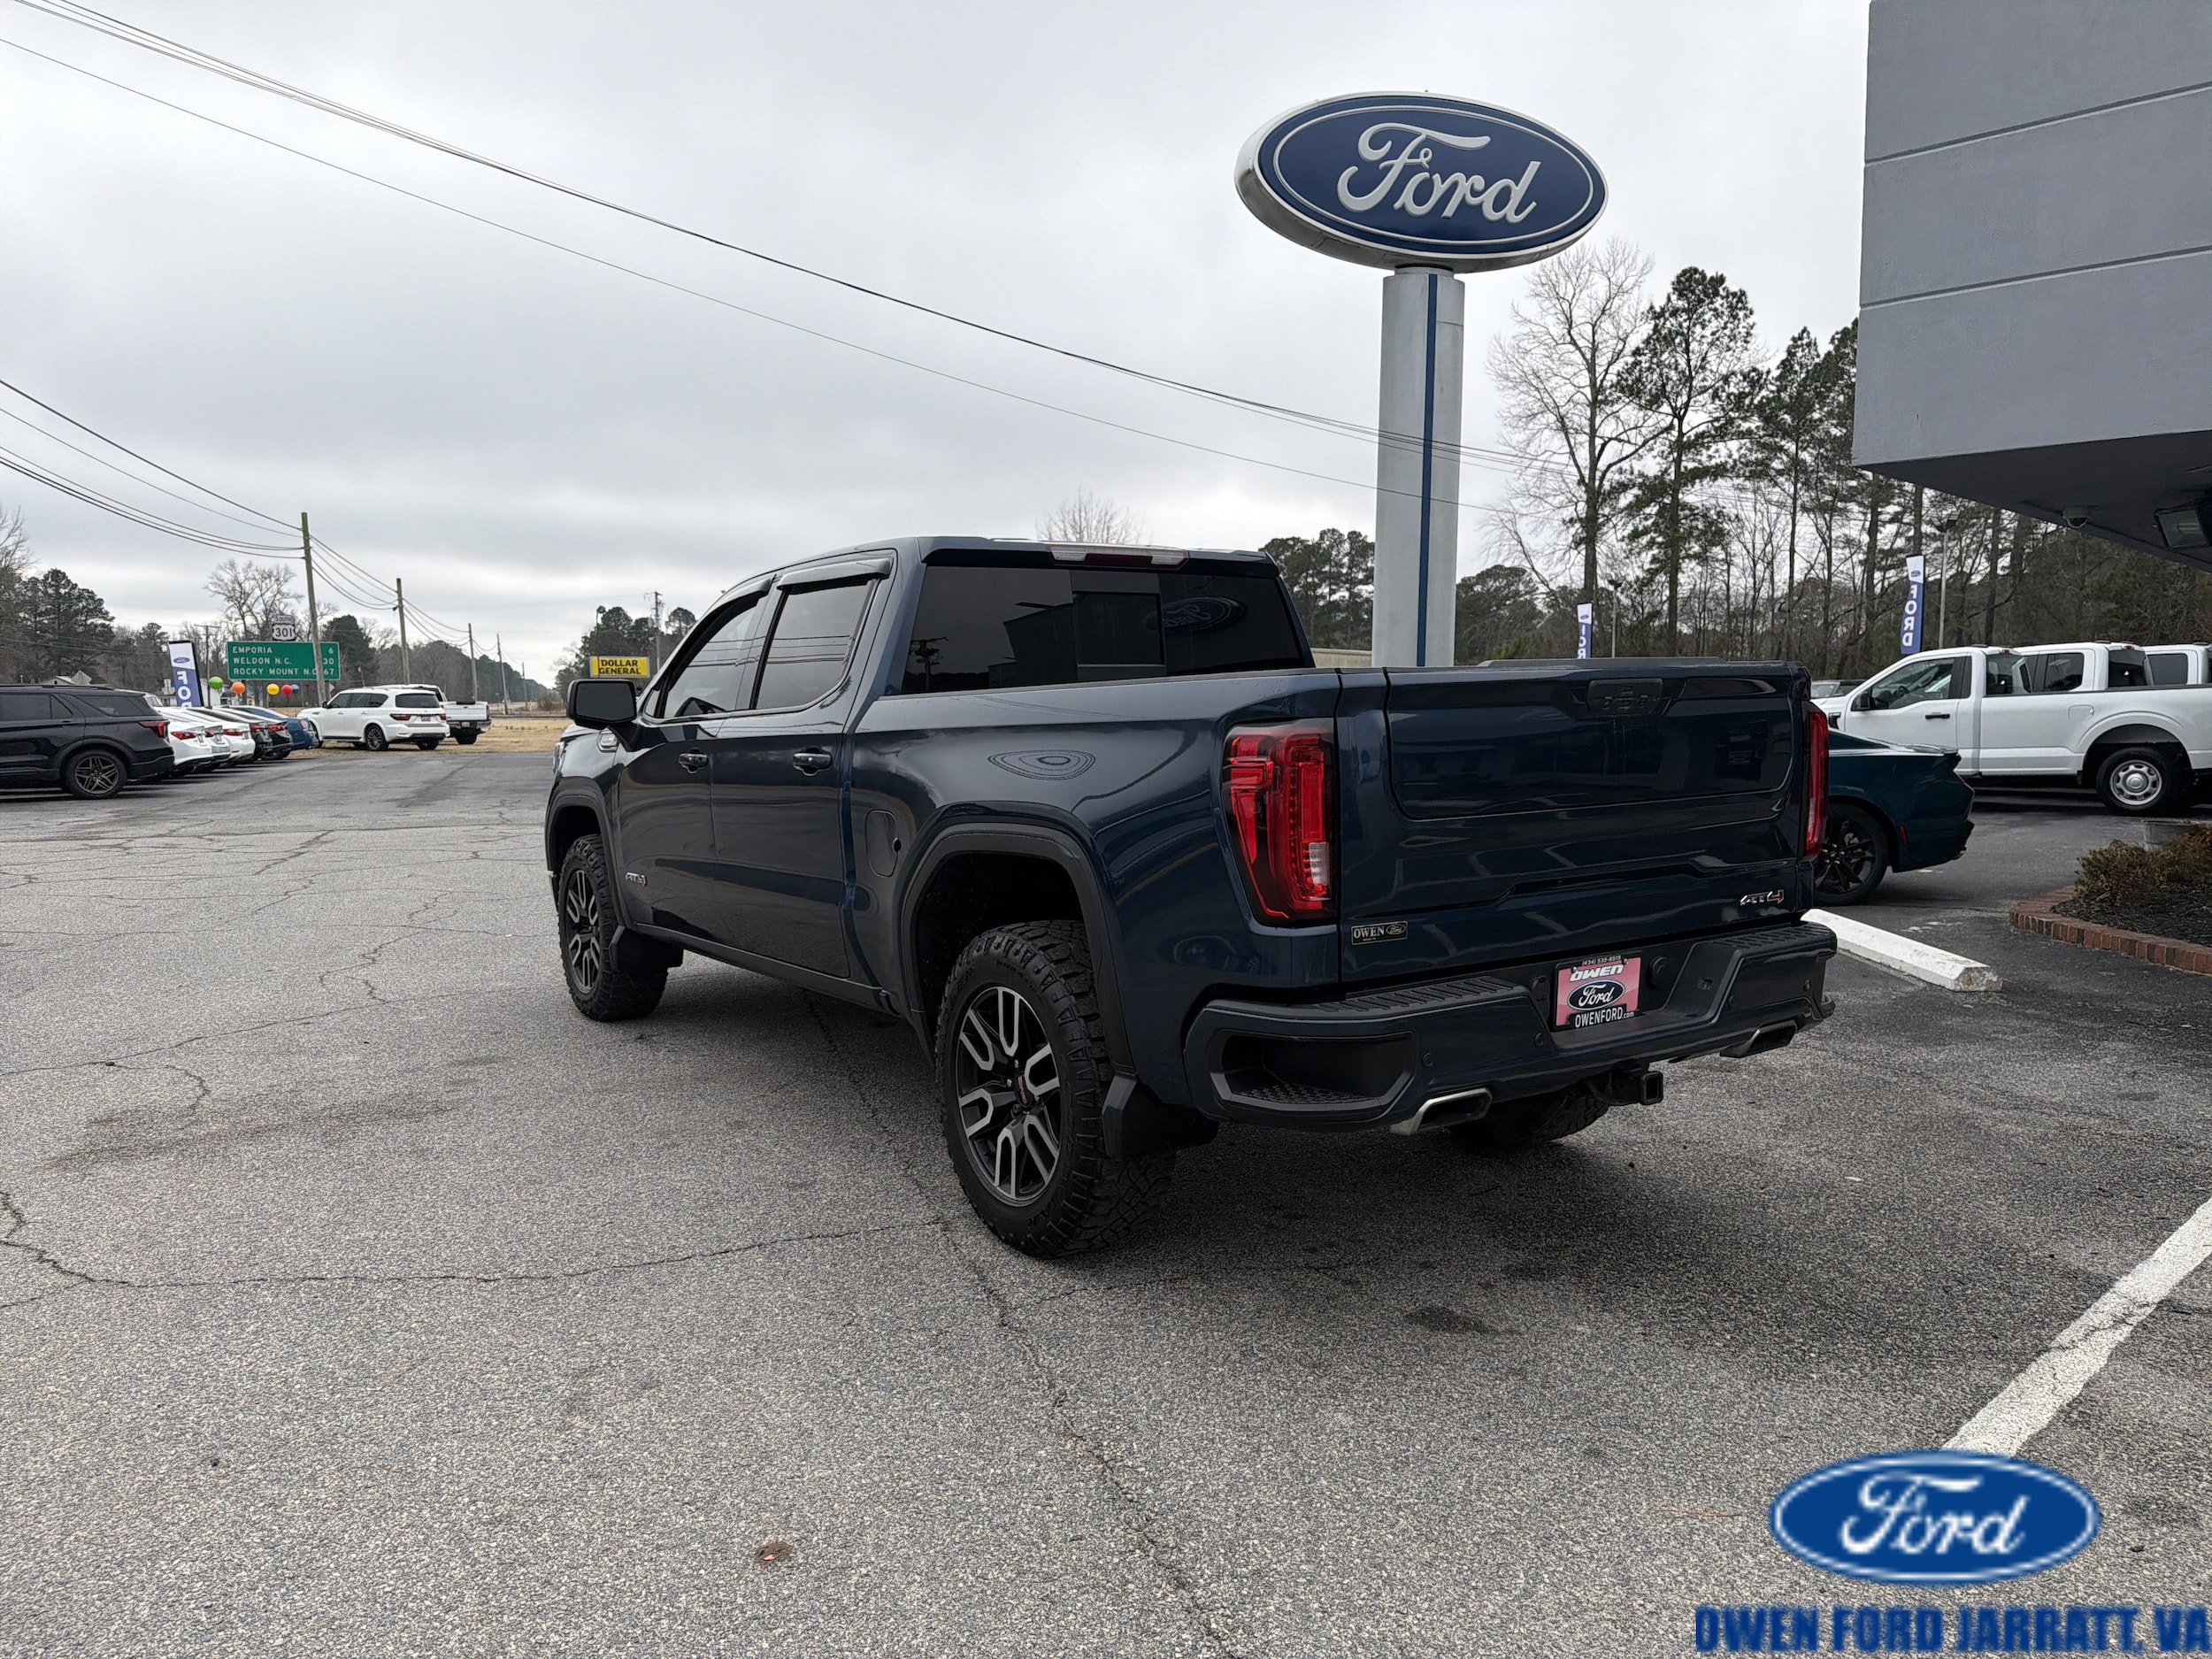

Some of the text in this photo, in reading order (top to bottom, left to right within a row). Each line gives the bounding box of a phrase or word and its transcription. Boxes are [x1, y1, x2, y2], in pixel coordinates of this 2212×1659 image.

[1337, 122, 1541, 225] Ford
[275, 627, 292, 637] 301
[625, 872, 647, 887] AT4
[1740, 889, 1785, 906] AT4
[1353, 926, 1385, 938] OWEN
[1570, 964, 1624, 982] OWEN
[1578, 982, 1616, 1007] Ford
[1575, 1007, 1635, 1028] OWENFORD.com
